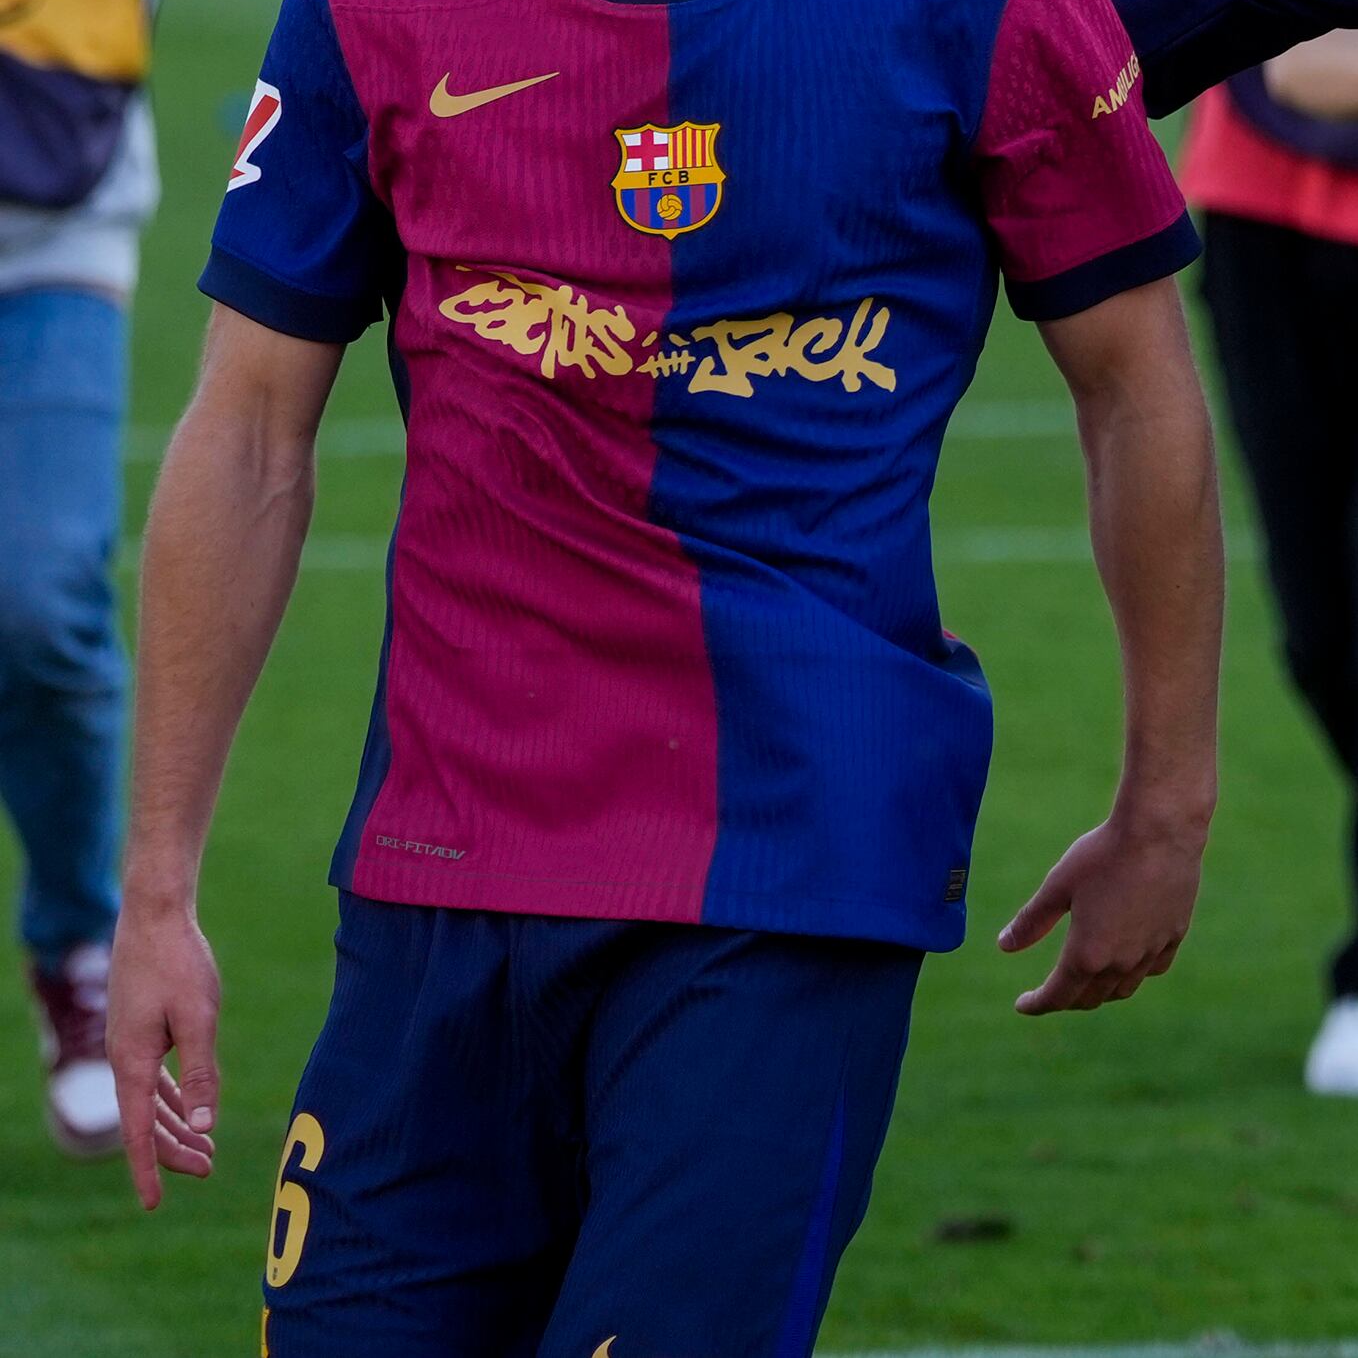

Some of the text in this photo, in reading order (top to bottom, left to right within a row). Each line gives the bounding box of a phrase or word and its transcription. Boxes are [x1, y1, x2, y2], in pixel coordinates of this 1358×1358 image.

[647, 170, 690, 186] FCB
[688, 297, 897, 399] Jack
[265, 1111, 325, 1288] 6
